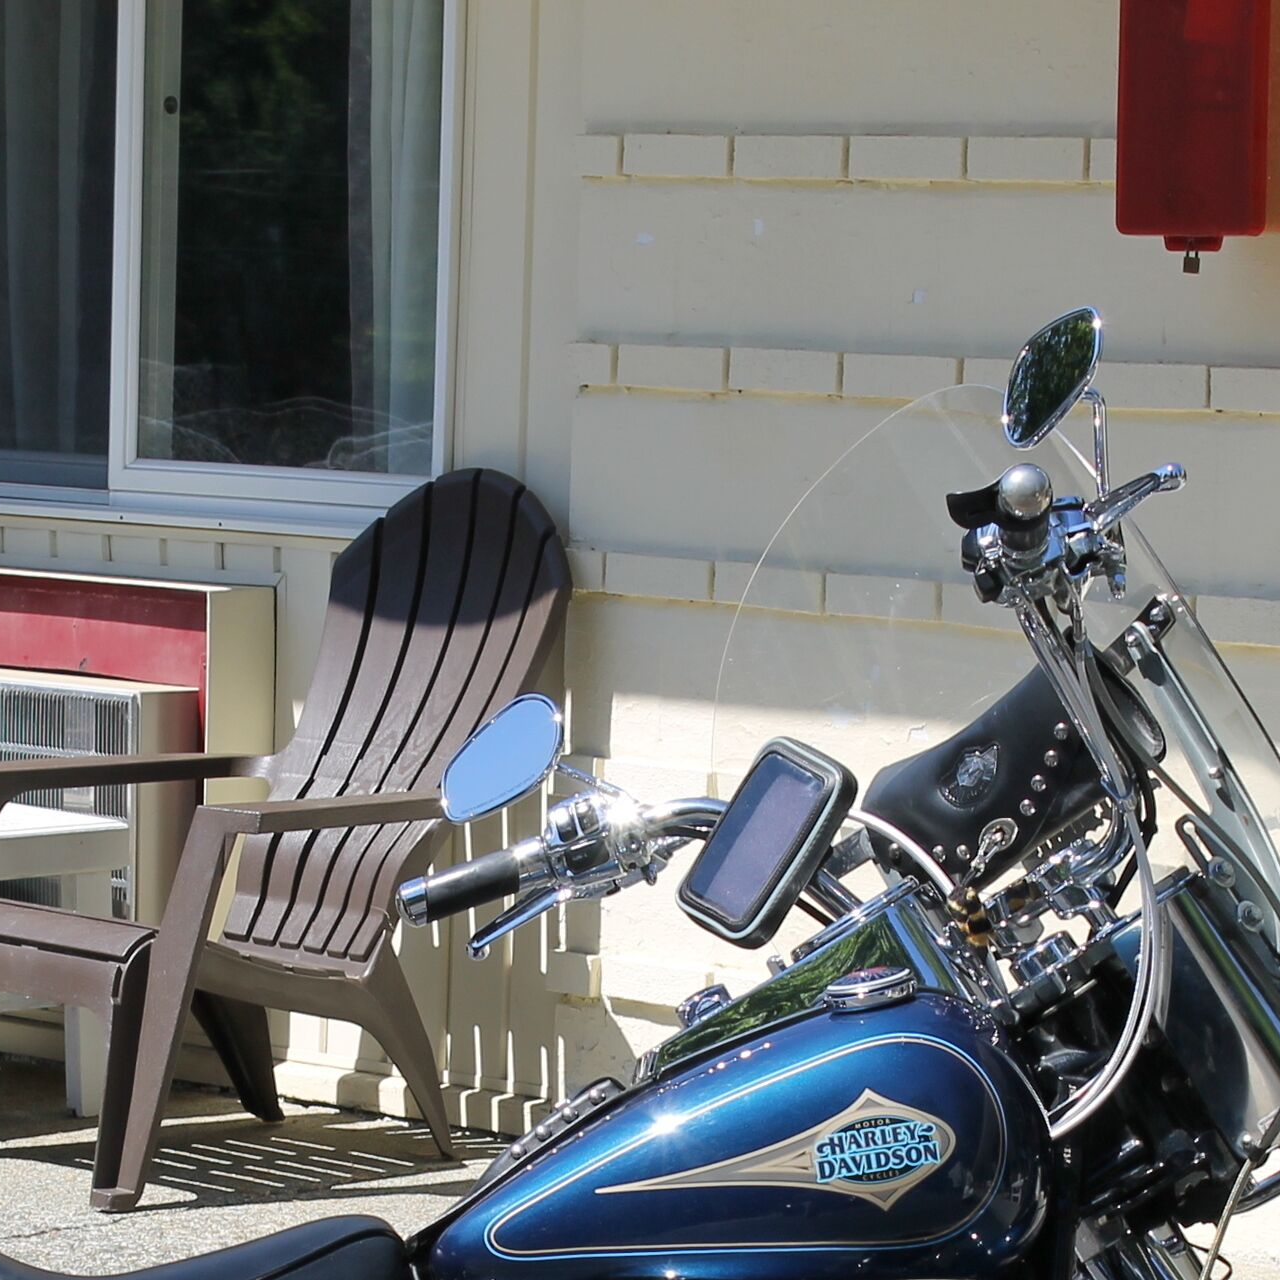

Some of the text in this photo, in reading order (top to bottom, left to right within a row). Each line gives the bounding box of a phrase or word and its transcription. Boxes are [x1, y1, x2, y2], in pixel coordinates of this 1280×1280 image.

[854, 1118, 891, 1129] MOTOR
[816, 1120, 937, 1159] HARLEY
[816, 1142, 942, 1184] DAVIDSON
[862, 1170, 900, 1182] CYCLES
